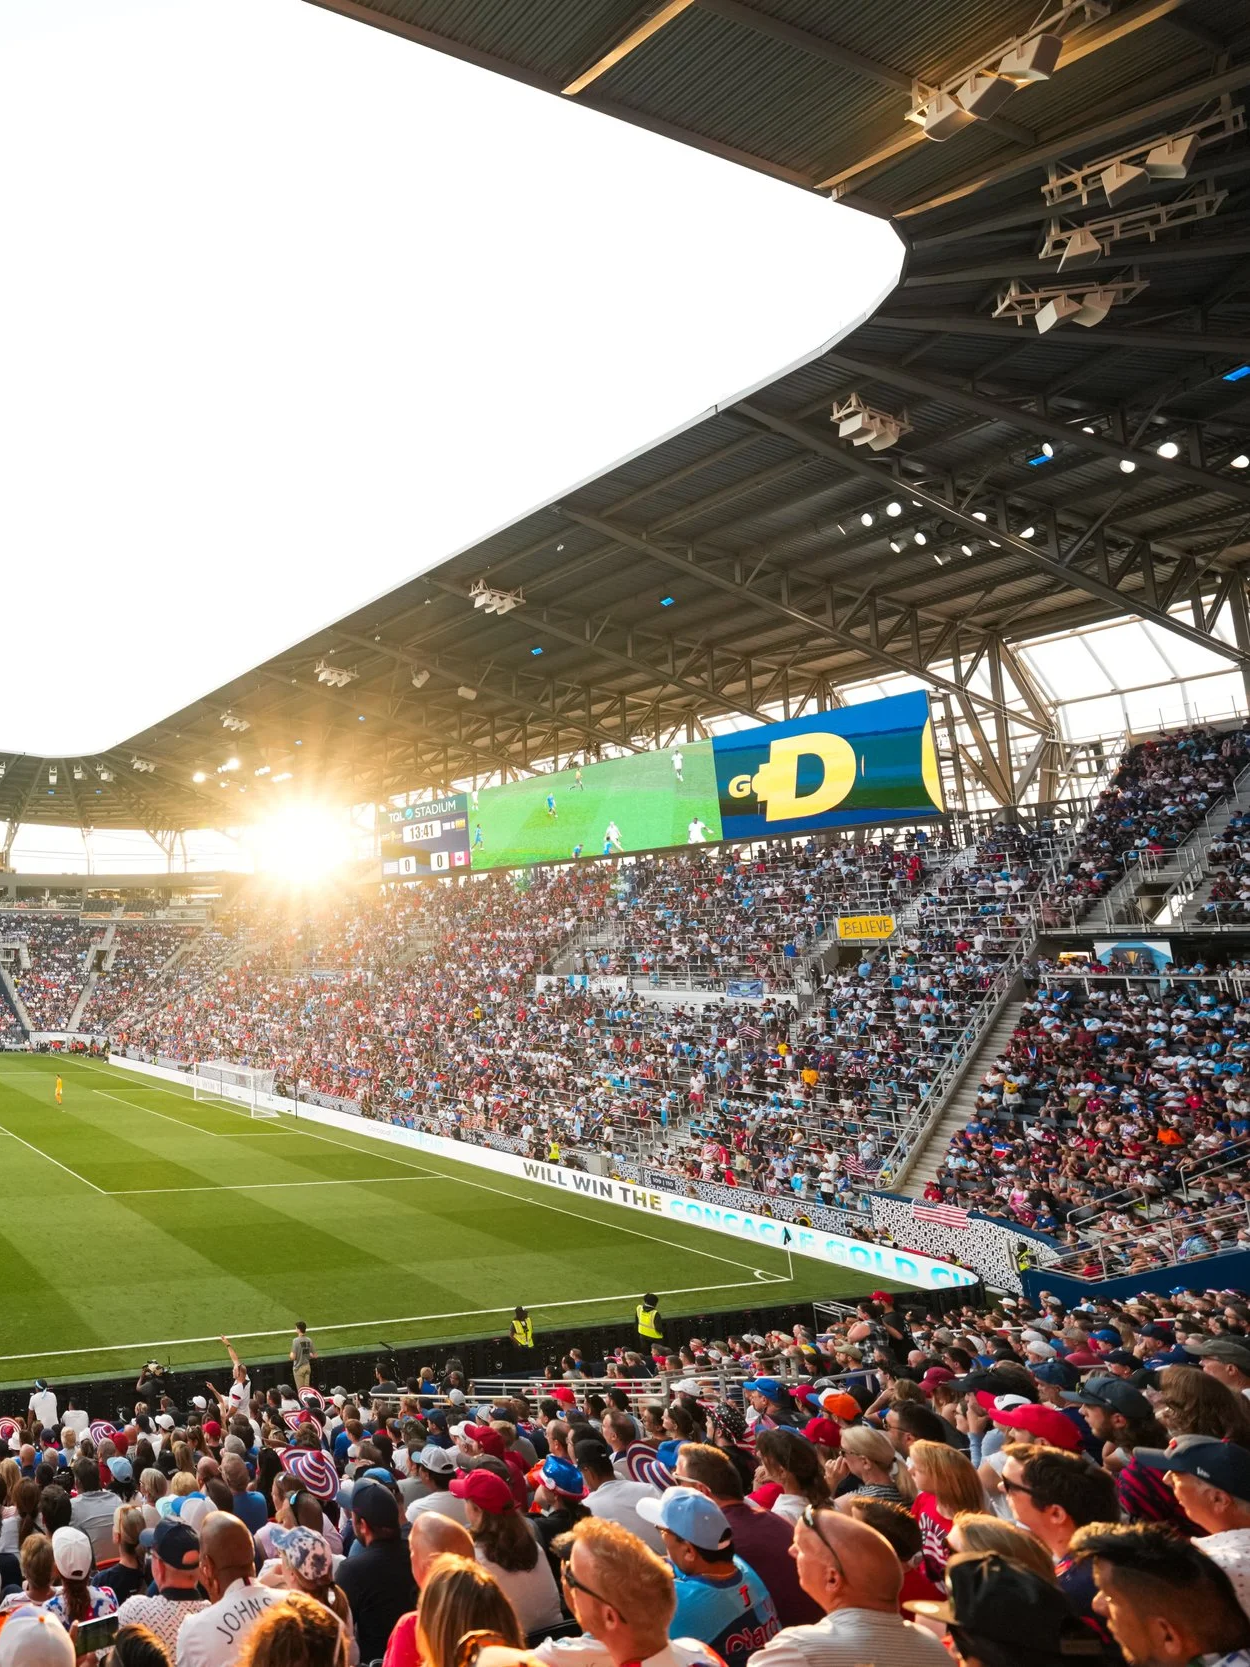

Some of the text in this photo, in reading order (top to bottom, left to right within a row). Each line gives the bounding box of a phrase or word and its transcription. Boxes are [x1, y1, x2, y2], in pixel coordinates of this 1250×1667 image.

[389, 800, 456, 823] TQL STADIUM
[410, 824, 434, 839] 13:41
[437, 854, 443, 867] 0
[843, 919, 892, 936] BELIEVE
[523, 1162, 567, 1186] WILL
[572, 1174, 613, 1199] WIN
[619, 1186, 662, 1211] THE
[670, 1200, 815, 1250] CONCACAF
[825, 1240, 918, 1279] GOLD
